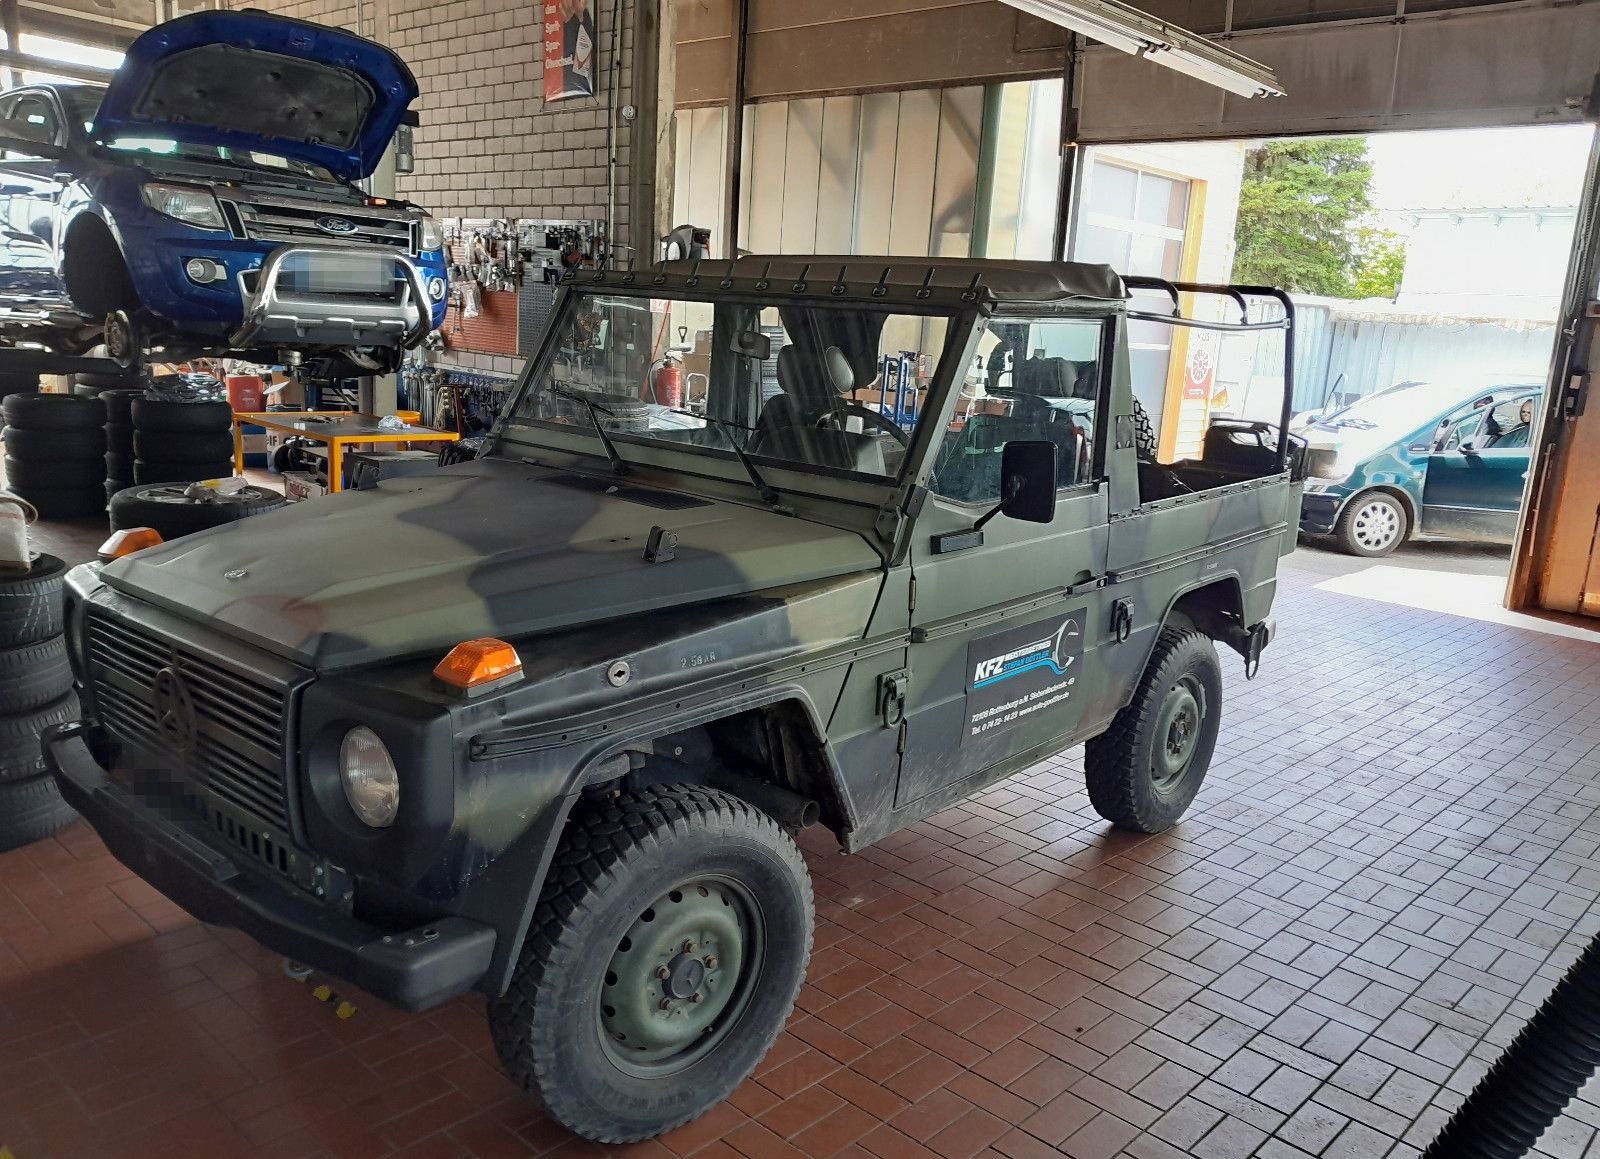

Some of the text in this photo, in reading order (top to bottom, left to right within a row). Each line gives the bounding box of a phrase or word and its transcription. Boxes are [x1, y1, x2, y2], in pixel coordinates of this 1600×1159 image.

[327, 218, 350, 231] Ford
[974, 655, 1005, 682] KFZ
[989, 699, 1019, 715] Rottenburg
